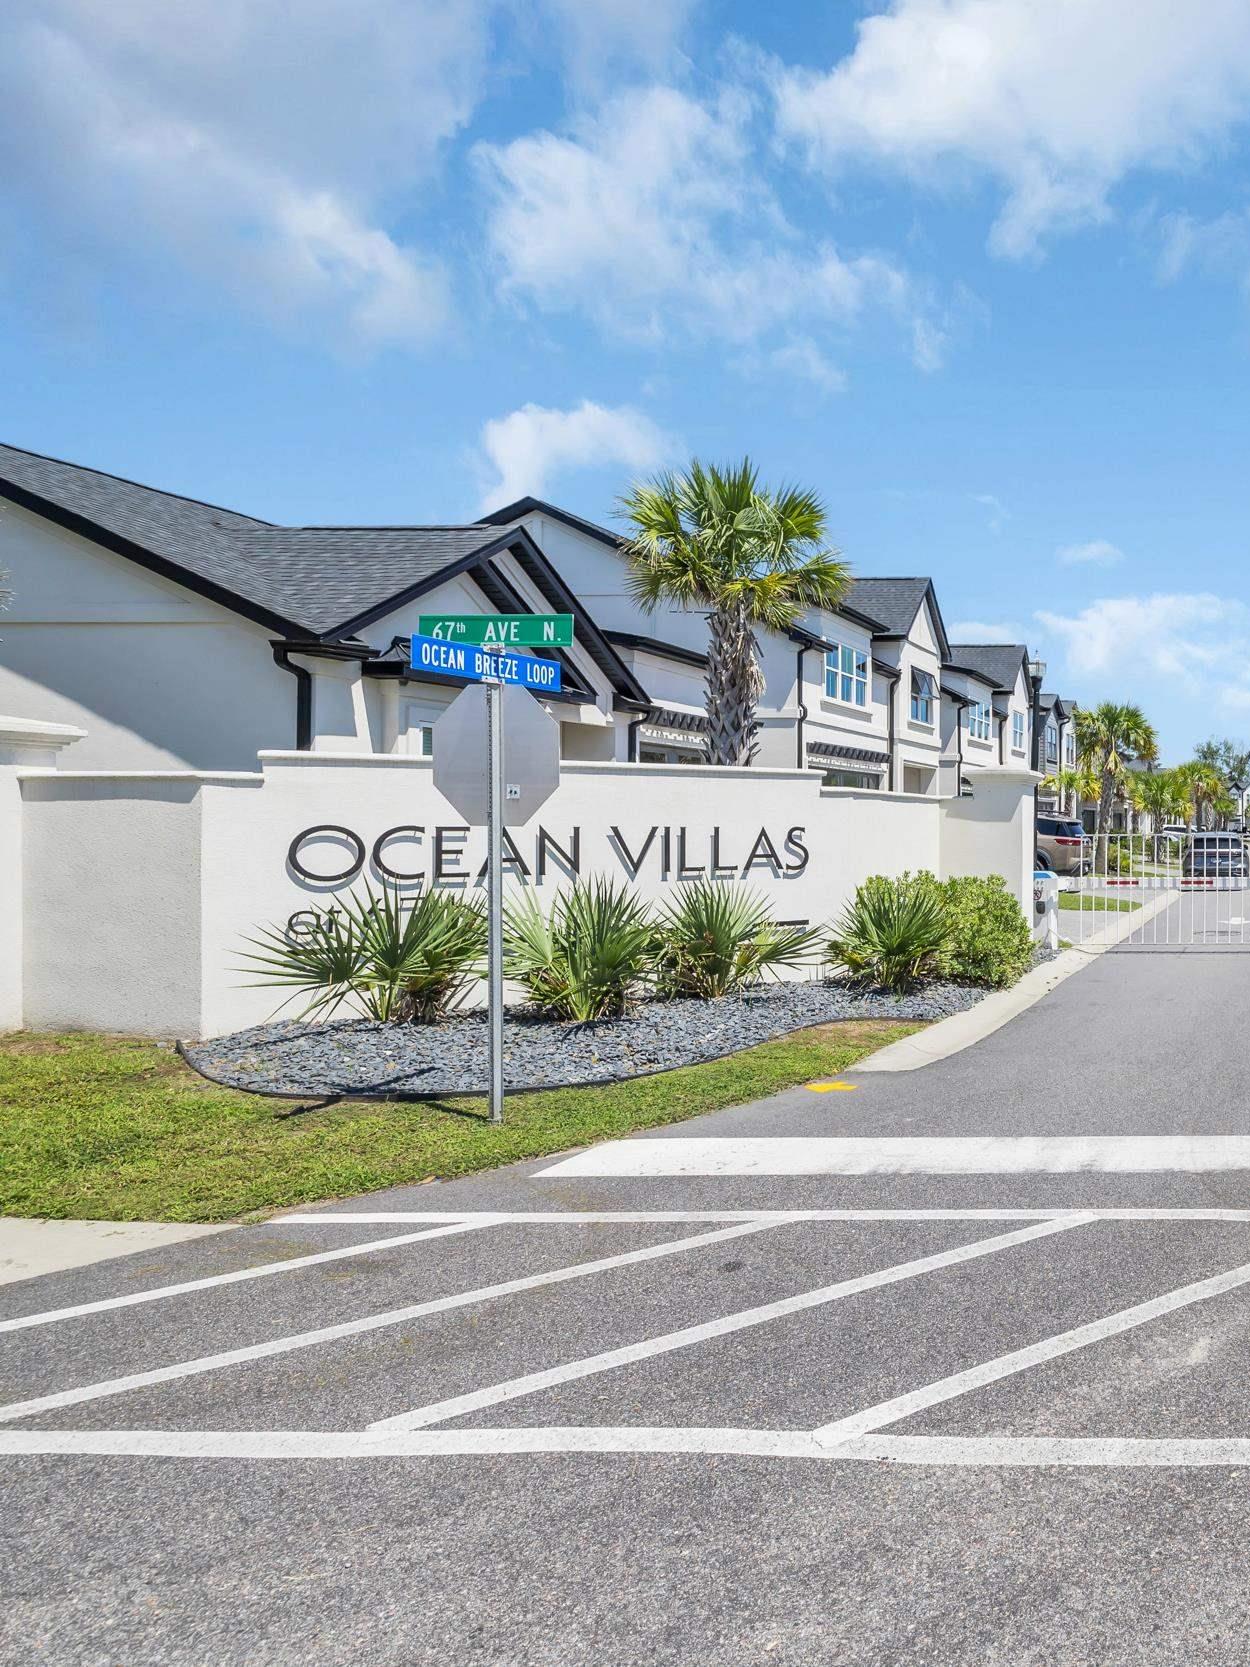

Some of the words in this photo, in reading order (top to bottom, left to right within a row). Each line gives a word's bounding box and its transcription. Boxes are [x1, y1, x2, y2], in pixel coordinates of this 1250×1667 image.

[432, 622, 466, 641] 67th
[484, 622, 520, 641] AVE
[543, 622, 562, 641] N.
[421, 643, 465, 671] OCEAN
[475, 653, 519, 680] BREEZE
[527, 663, 555, 685] LOOP
[288, 825, 580, 881] OCEAN
[610, 826, 810, 873] VILLAS
